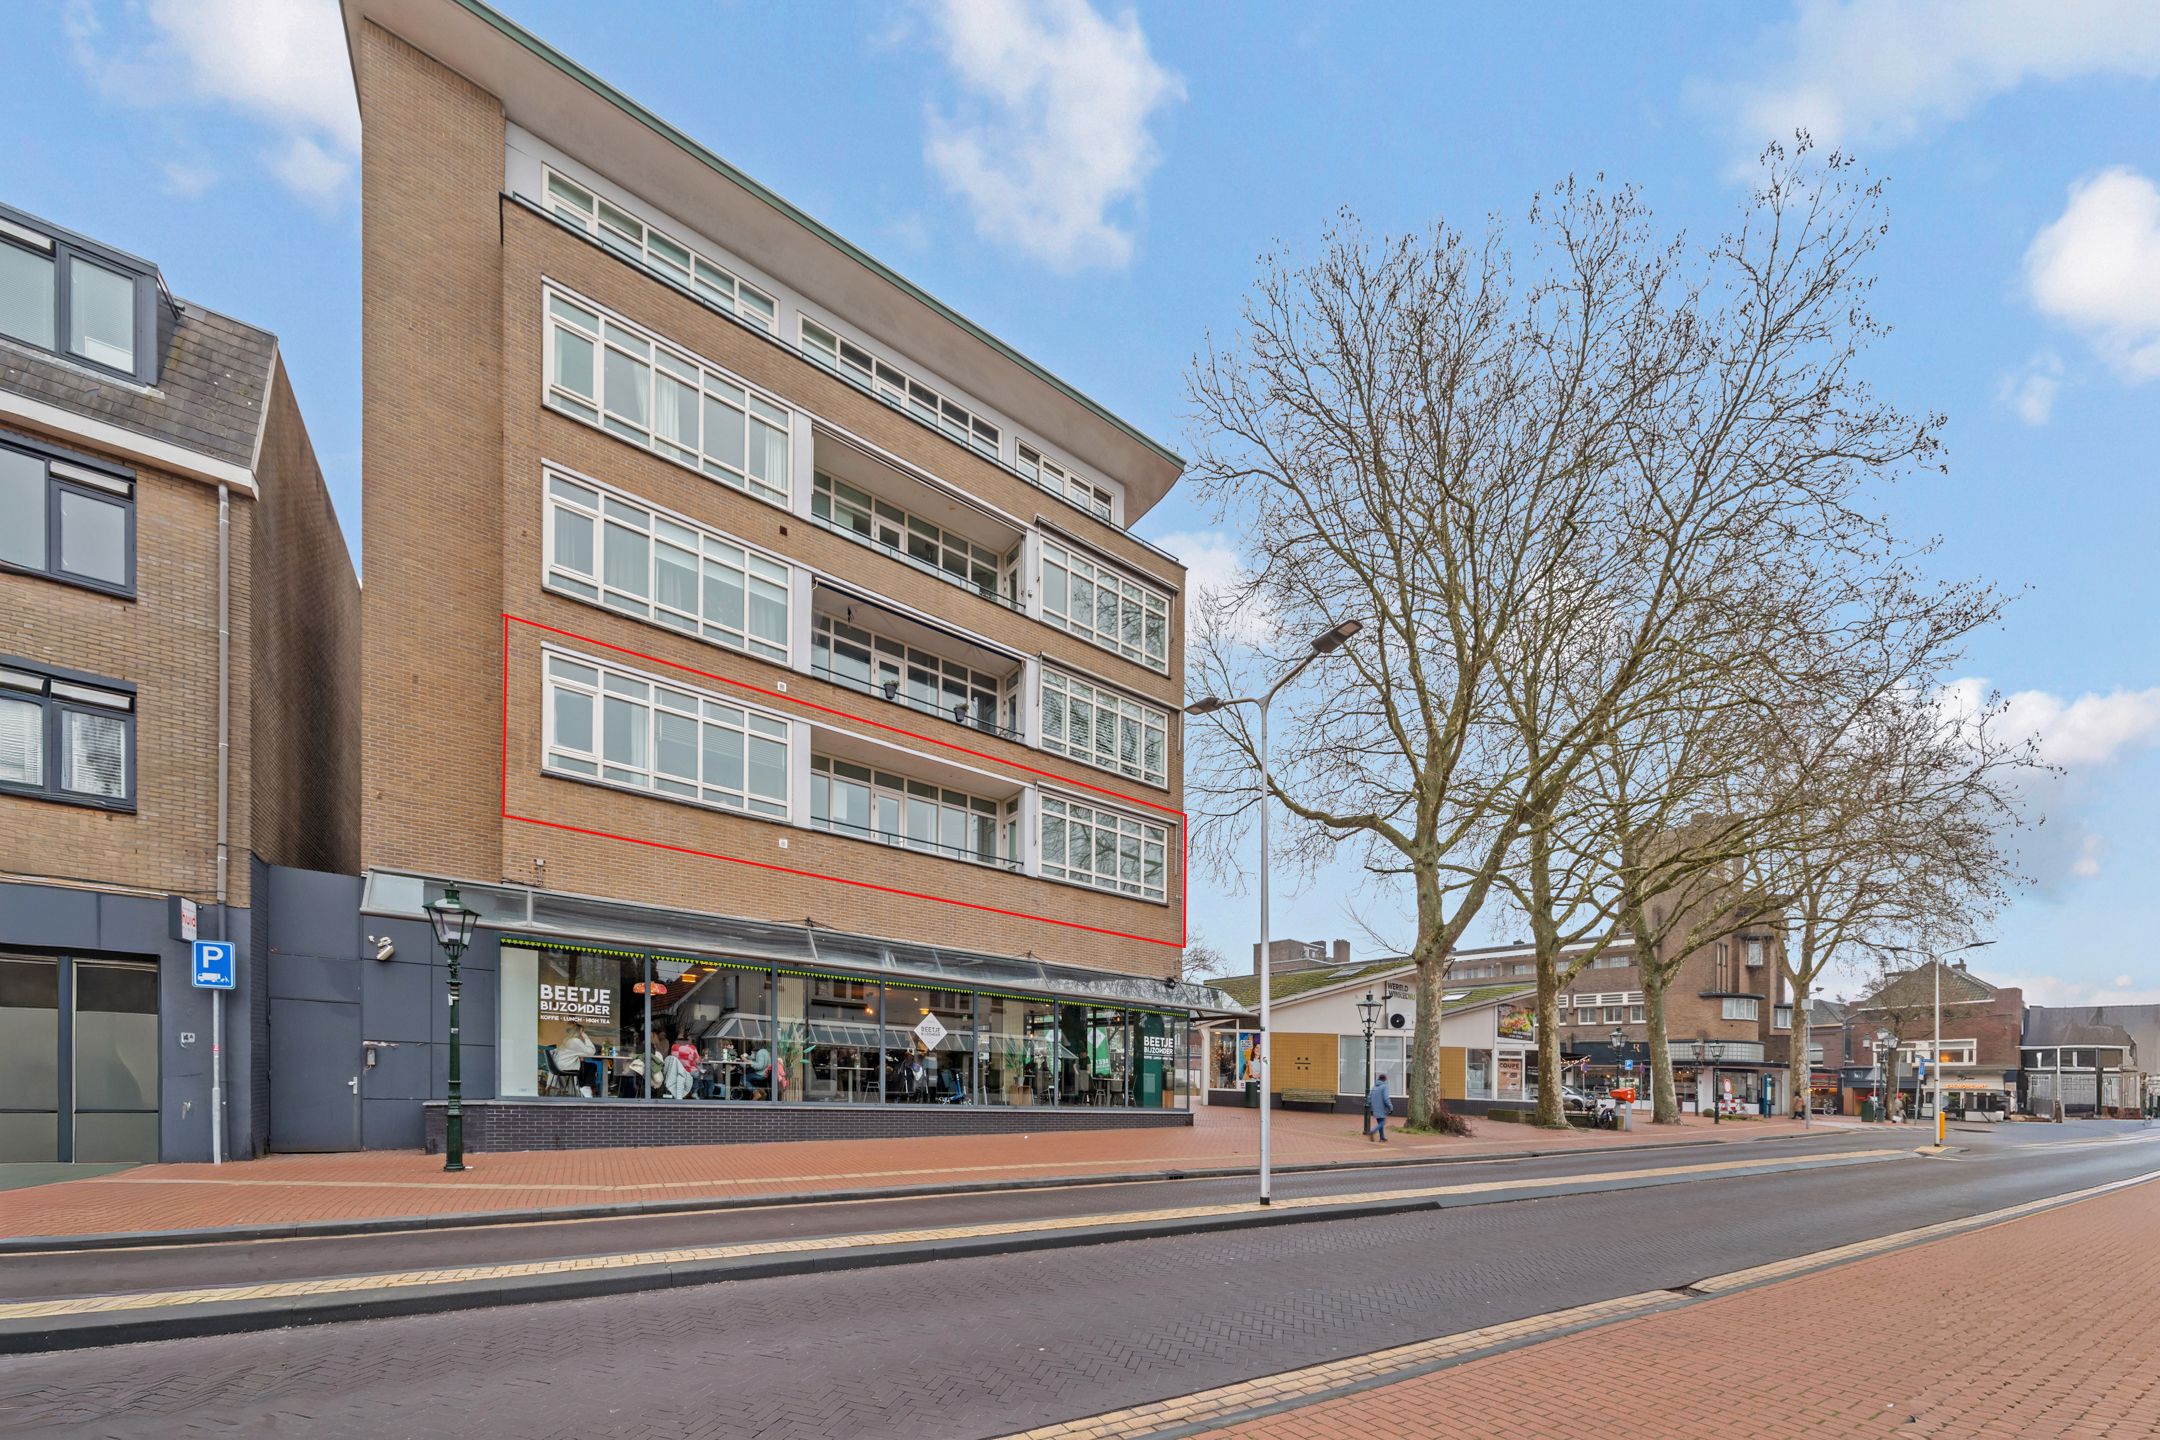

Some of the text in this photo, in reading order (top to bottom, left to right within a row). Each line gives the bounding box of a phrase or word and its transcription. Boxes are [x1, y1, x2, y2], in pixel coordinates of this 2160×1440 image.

[202, 945, 223, 968] P
[540, 984, 611, 1004] BEETJE
[541, 1001, 610, 1015] BIJZONDER
[1144, 1036, 1173, 1048] BEETJE
